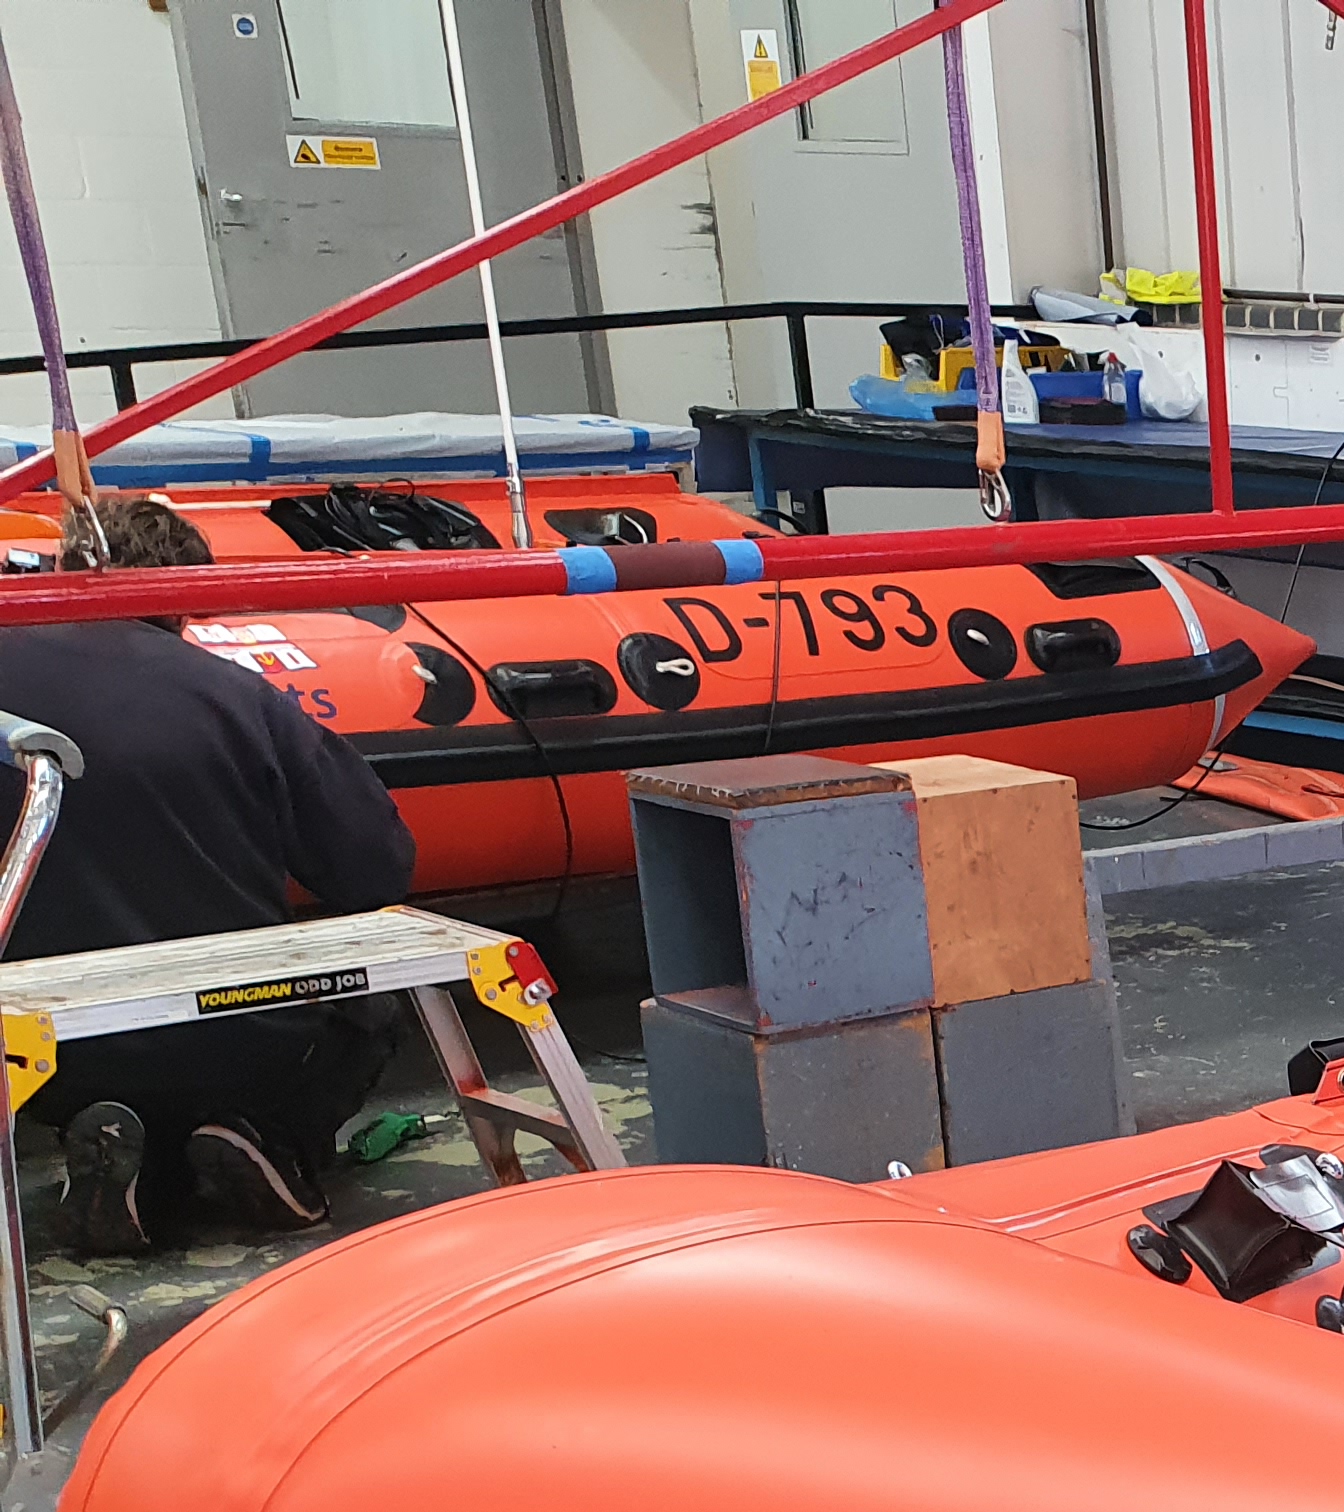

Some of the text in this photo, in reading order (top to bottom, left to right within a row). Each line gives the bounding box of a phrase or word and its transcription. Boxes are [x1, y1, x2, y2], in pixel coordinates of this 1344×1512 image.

[663, 584, 938, 664] D-793
[200, 972, 367, 1009] YOUNGMAN ODD JOB
